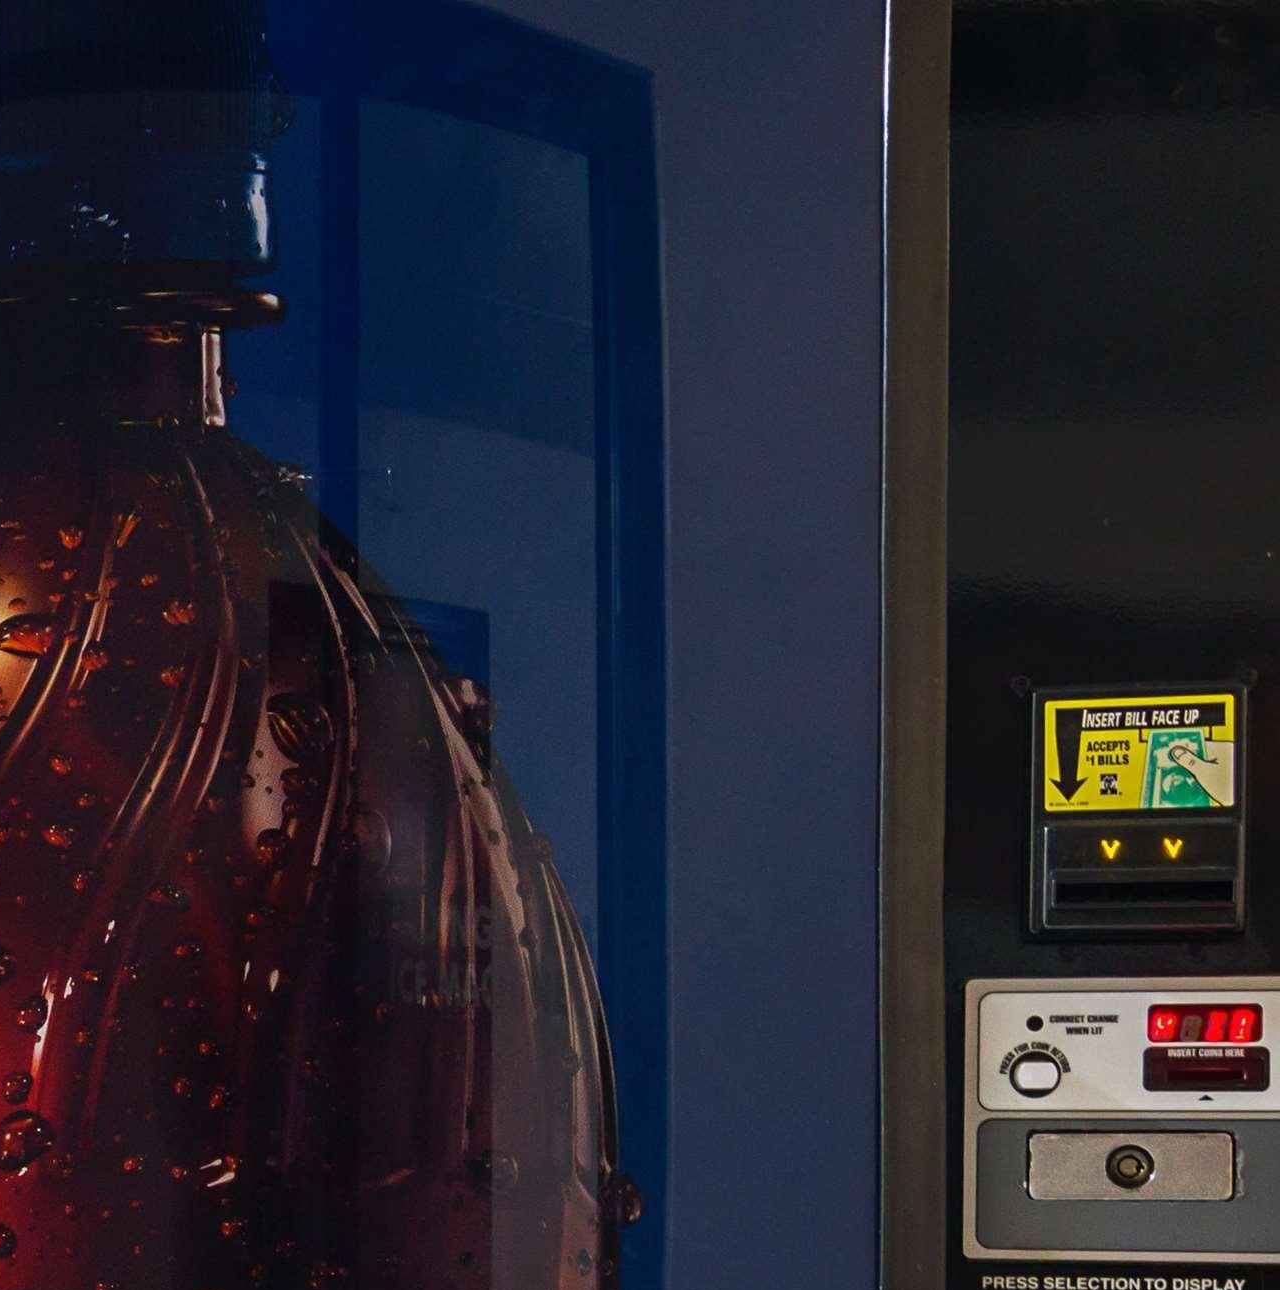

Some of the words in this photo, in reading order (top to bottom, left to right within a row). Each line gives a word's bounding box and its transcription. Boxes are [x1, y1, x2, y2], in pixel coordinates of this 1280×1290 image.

[1081, 709, 1122, 728] INSERT
[1125, 712, 1148, 726] BILL
[1152, 710, 1180, 726] FACE
[1184, 709, 1200, 725] UP
[1086, 741, 1130, 752] ACCEPTS
[1098, 754, 1129, 766] BILLS
[1049, 1015, 1085, 1023] CORRECT
[1087, 1015, 1119, 1023] CHANGE
[1066, 1027, 1089, 1035] WHEN
[1091, 1027, 1103, 1035] LIT
[1031, 1041, 1050, 1051] COIN
[982, 1276, 1039, 1289] PRESS
[1043, 1277, 1141, 1290] SELECTION
[1144, 1278, 1167, 1290] TO
